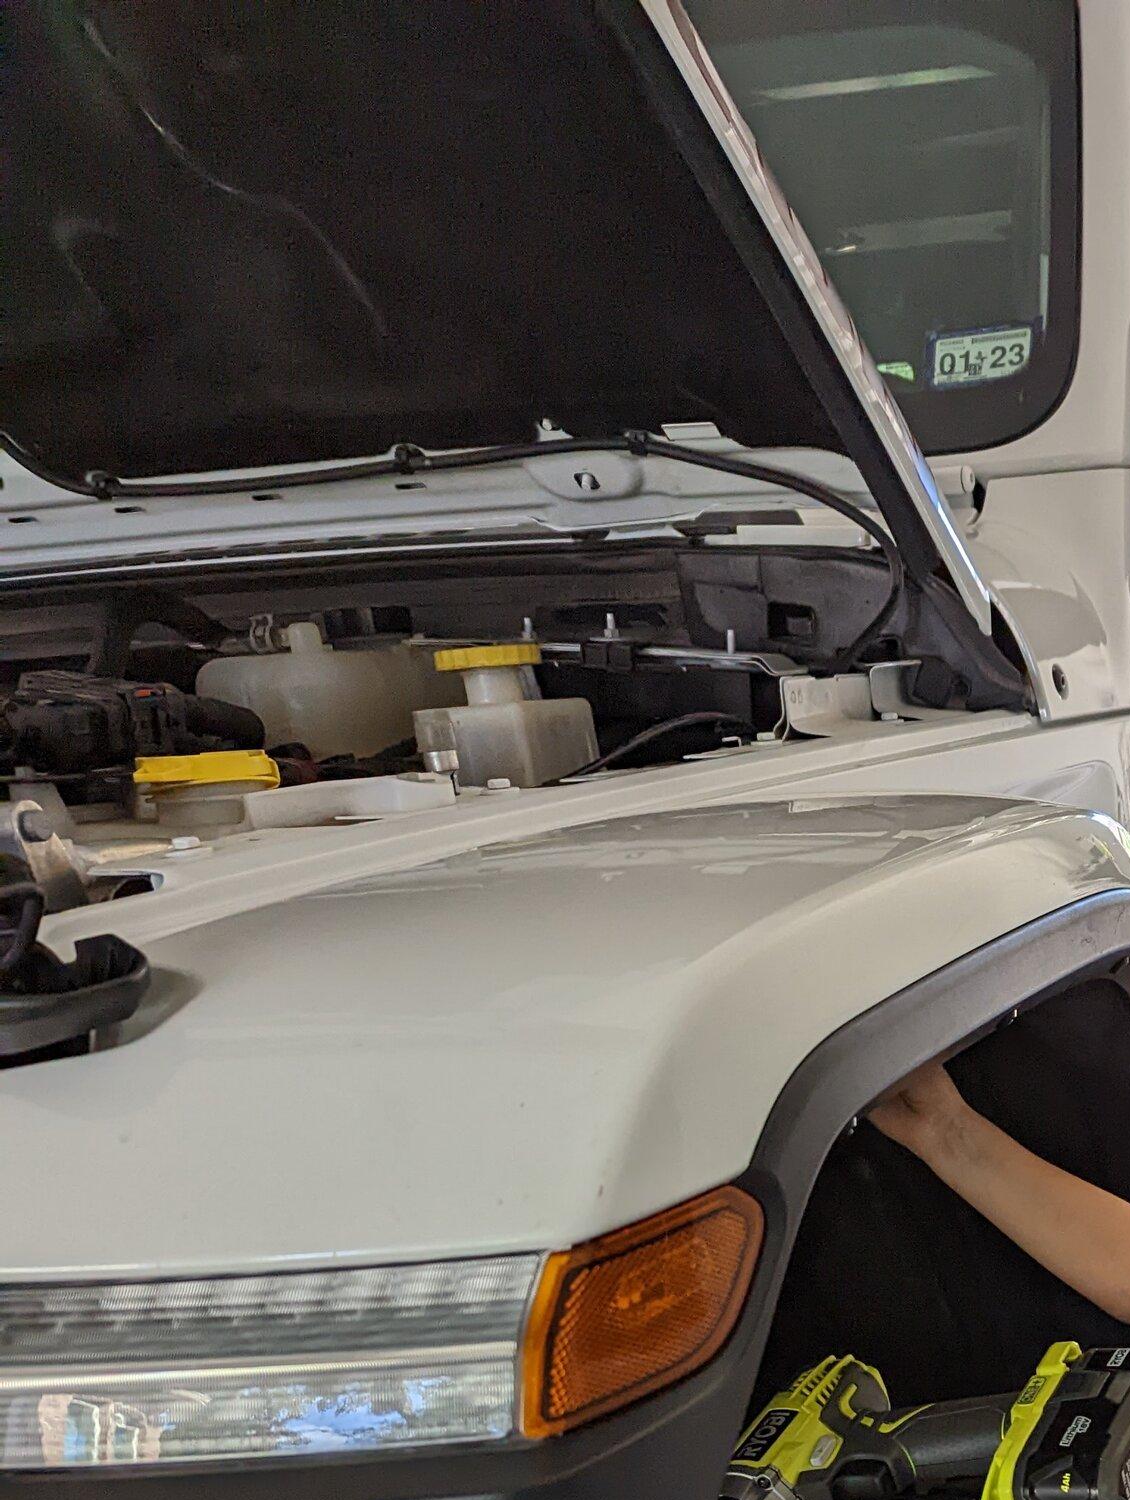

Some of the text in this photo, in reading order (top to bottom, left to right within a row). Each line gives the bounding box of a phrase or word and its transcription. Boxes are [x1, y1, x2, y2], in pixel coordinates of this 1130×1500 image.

[939, 343, 1025, 376] 01 23
[737, 1411, 790, 1457] RYOBI
[1060, 1472, 1071, 1493] 4Ah
